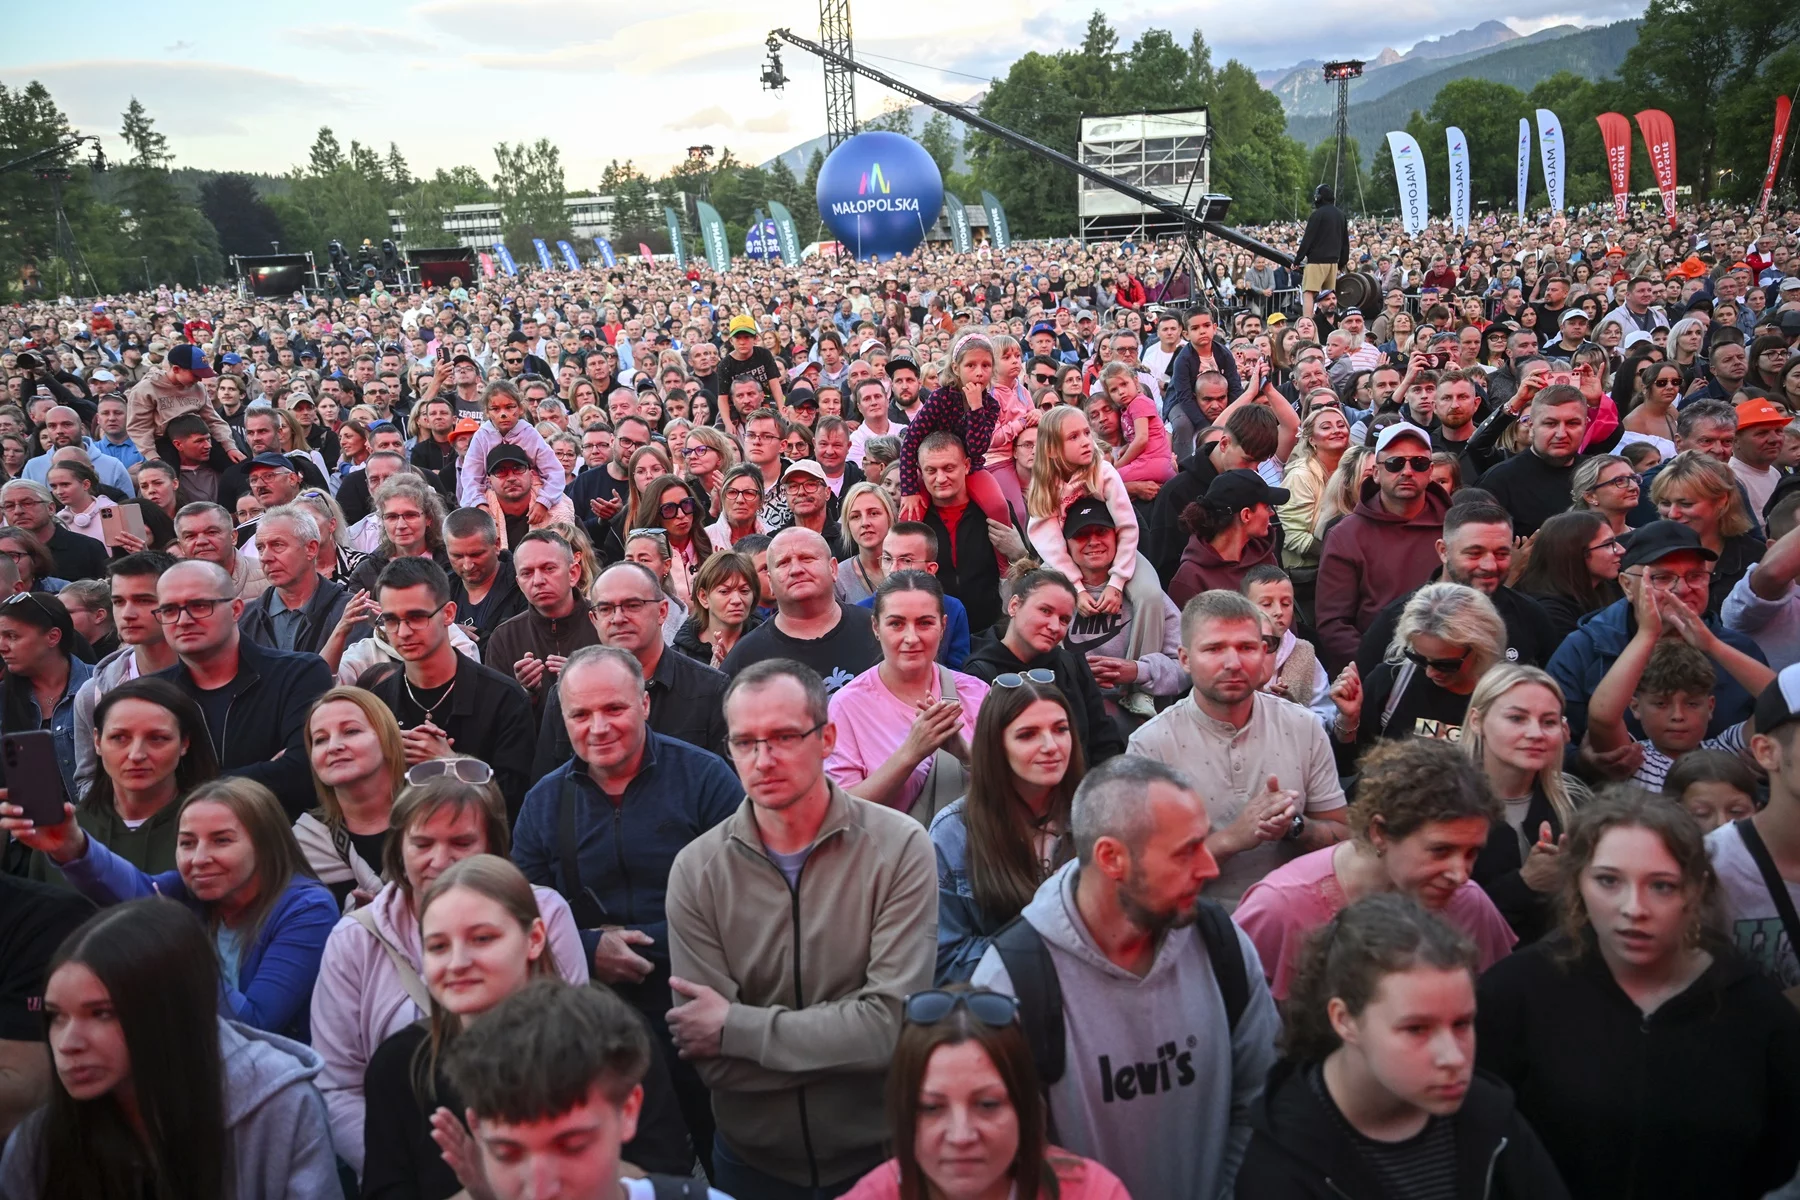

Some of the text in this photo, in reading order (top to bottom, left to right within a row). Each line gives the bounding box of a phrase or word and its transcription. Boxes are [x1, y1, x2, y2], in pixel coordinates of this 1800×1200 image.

[832, 198, 919, 216] MAŁOPOLSKA
[1071, 612, 1122, 634] NIKE
[1098, 1041, 1196, 1103] levi's
